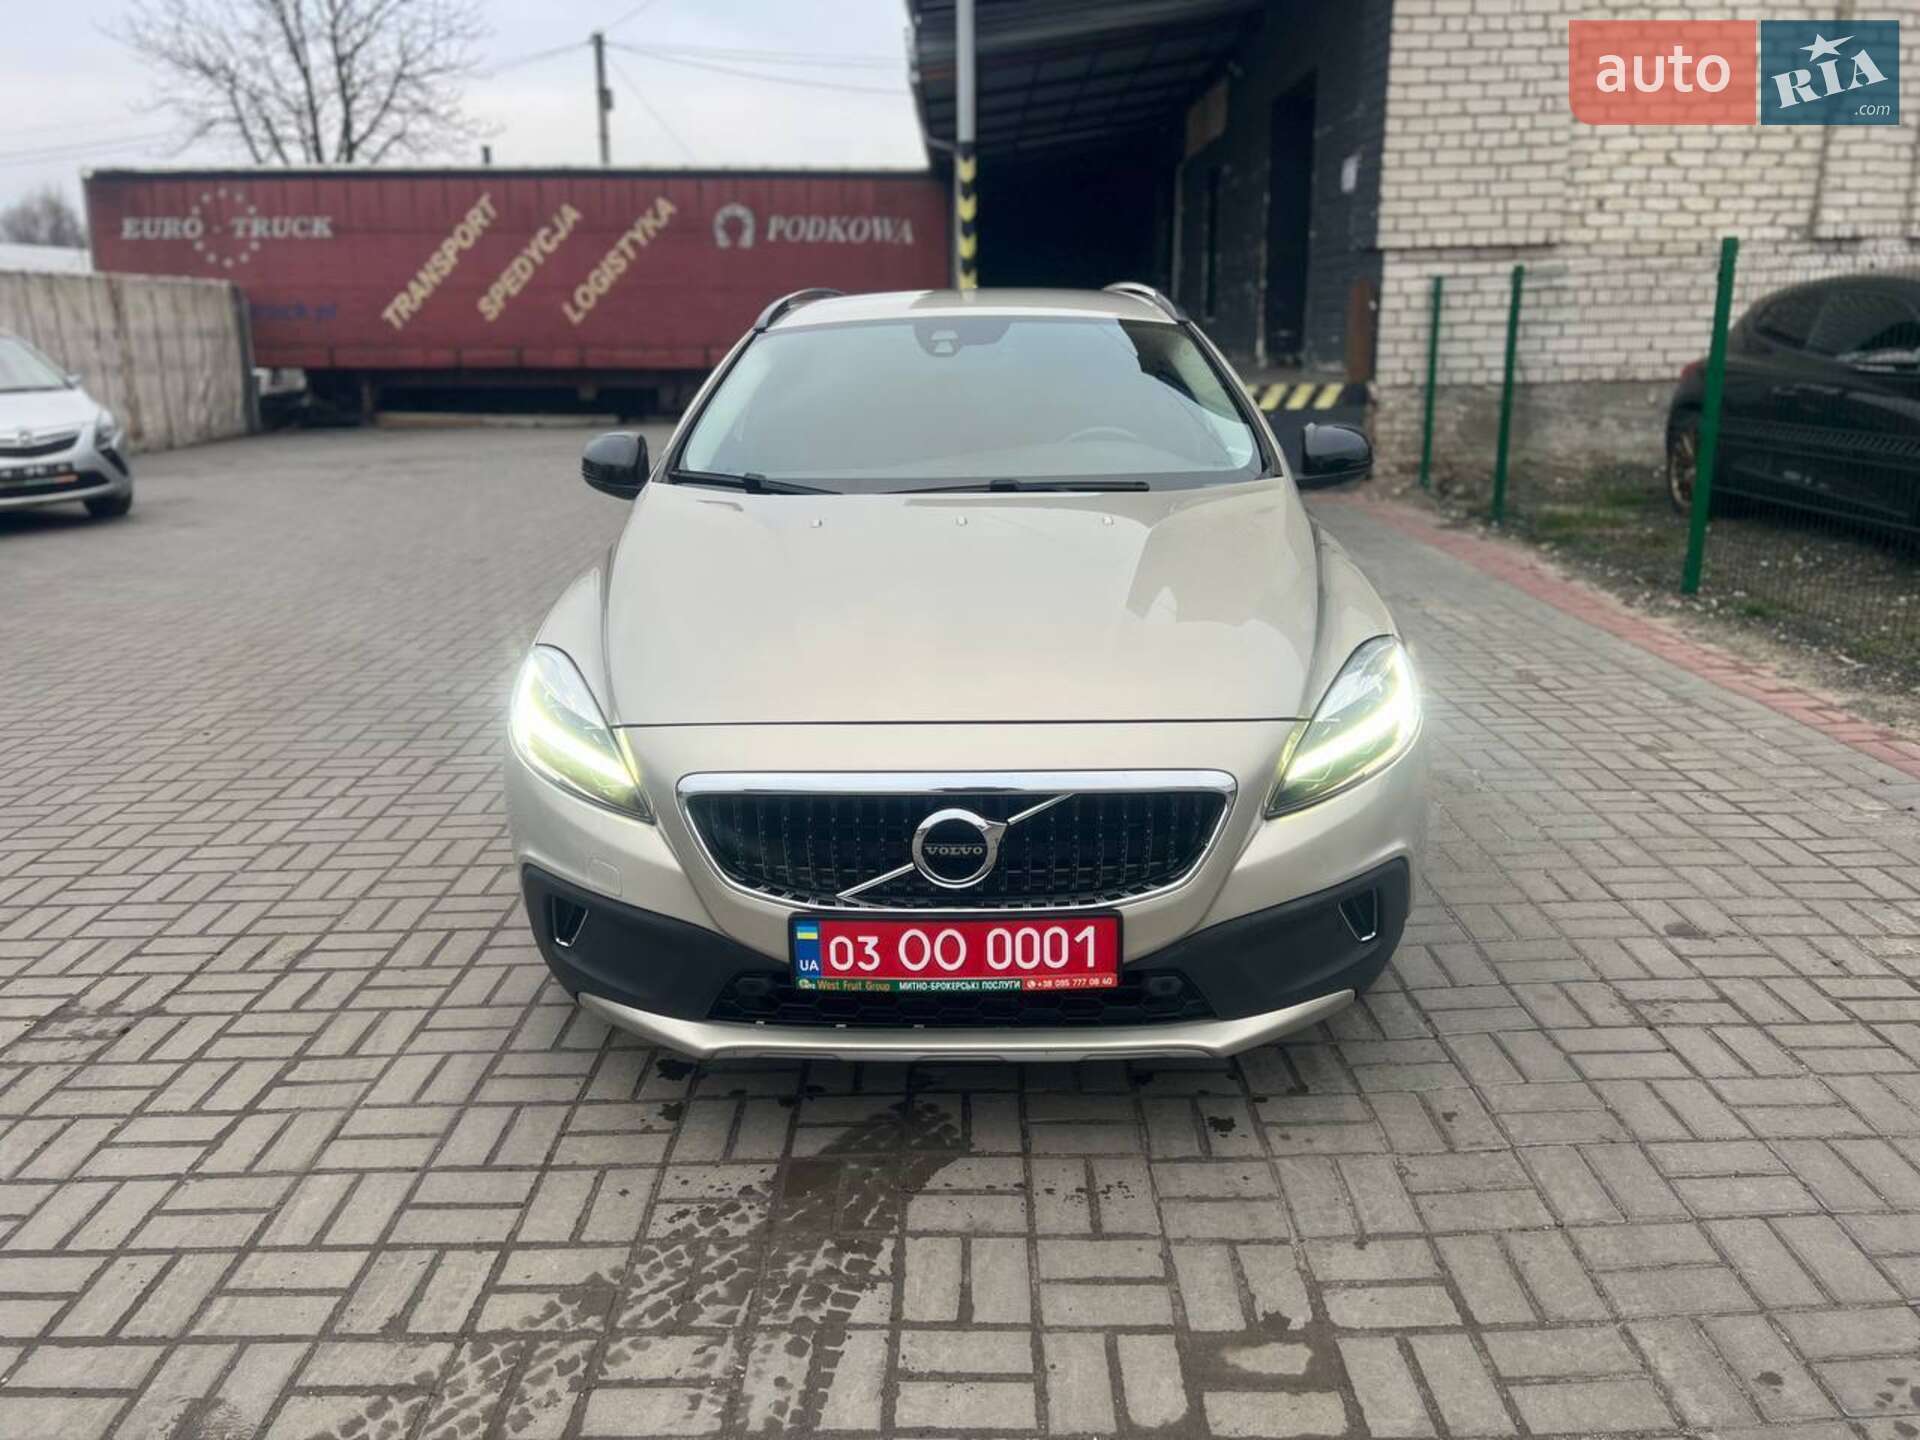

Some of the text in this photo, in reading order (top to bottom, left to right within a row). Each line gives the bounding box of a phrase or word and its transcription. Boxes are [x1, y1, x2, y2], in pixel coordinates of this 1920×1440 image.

[121, 216, 334, 239] EURO TRUCK
[767, 215, 915, 245] PODKOWA
[381, 192, 498, 331] TRANSPORT
[476, 202, 582, 323] SPEDYCJA
[561, 196, 677, 325] LOGISTYKA
[925, 846, 983, 856] VOLVO
[828, 935, 881, 971] 03
[986, 925, 1095, 970] 0001
[799, 960, 819, 971] UA
[817, 979, 840, 990] West
[843, 979, 862, 990] Fruit
[866, 980, 890, 992] Group
[981, 980, 1021, 990] ПОСЛУГИ
